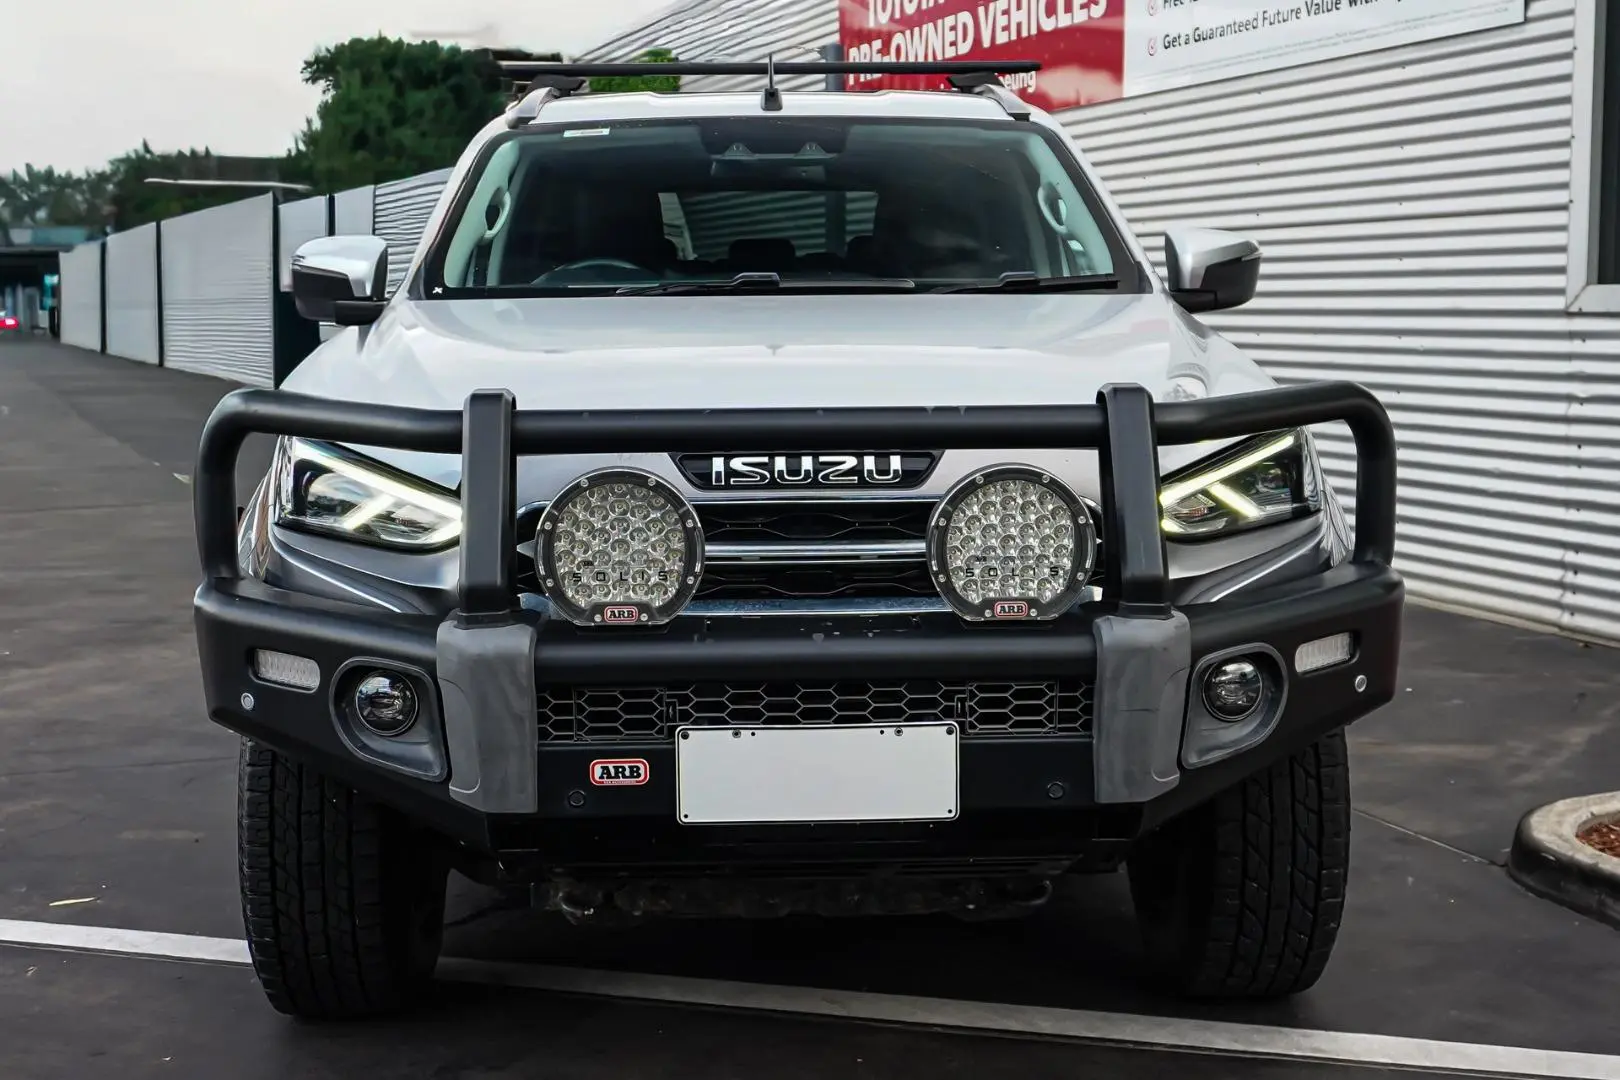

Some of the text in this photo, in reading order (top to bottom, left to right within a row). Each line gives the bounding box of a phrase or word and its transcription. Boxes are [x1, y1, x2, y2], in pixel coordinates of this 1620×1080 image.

[867, 0, 945, 28] TOY
[1163, 32, 1182, 49] Get
[1184, 33, 1190, 45] a
[1193, 12, 1259, 43] Guaranteed
[1262, 8, 1301, 27] Future
[1304, 0, 1341, 17] Value
[848, 10, 975, 85] PRE-OWNED
[712, 455, 902, 486] ISUZU
[573, 571, 668, 582] SOLIS
[965, 567, 1059, 577] SOLIS
[608, 609, 635, 619] ARB
[999, 605, 1025, 614] ARB
[598, 765, 642, 779] ARB
